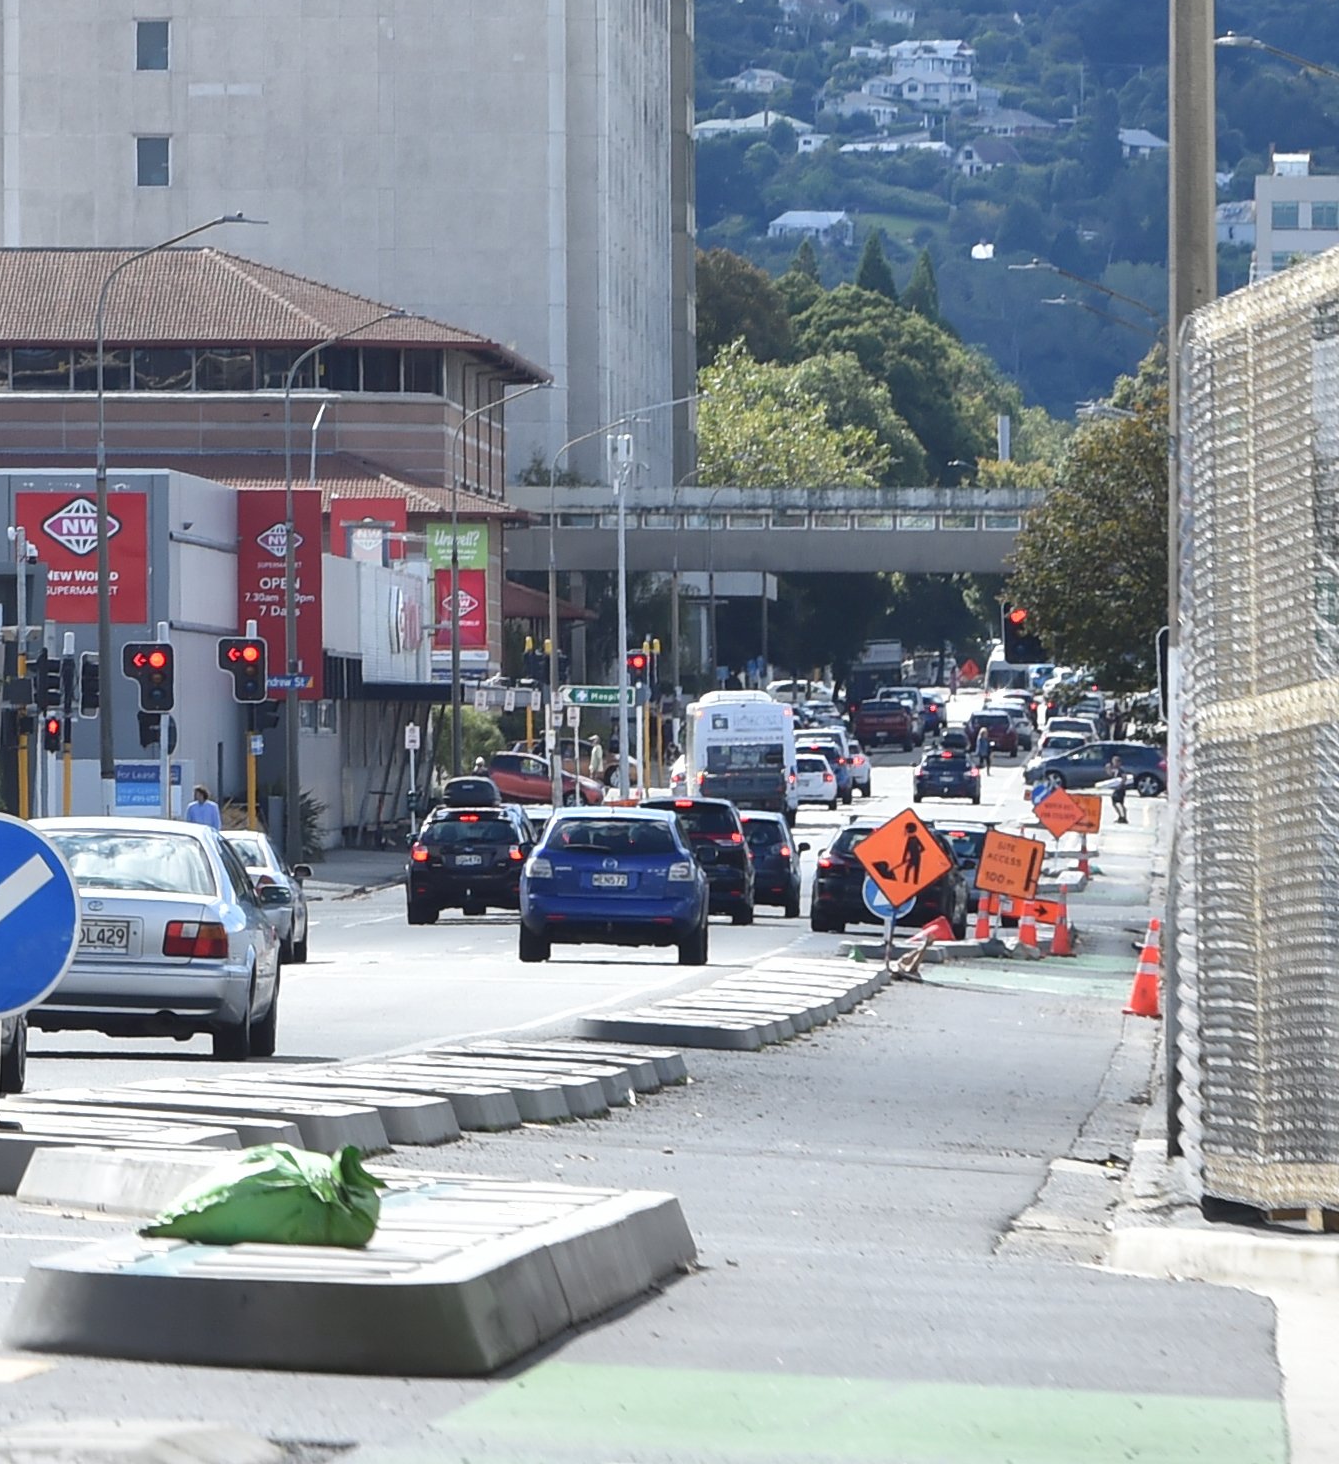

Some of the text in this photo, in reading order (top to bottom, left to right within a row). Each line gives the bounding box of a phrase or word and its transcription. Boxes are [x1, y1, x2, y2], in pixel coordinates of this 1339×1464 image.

[259, 605, 300, 617] 7 Das
[294, 676, 305, 688] St
